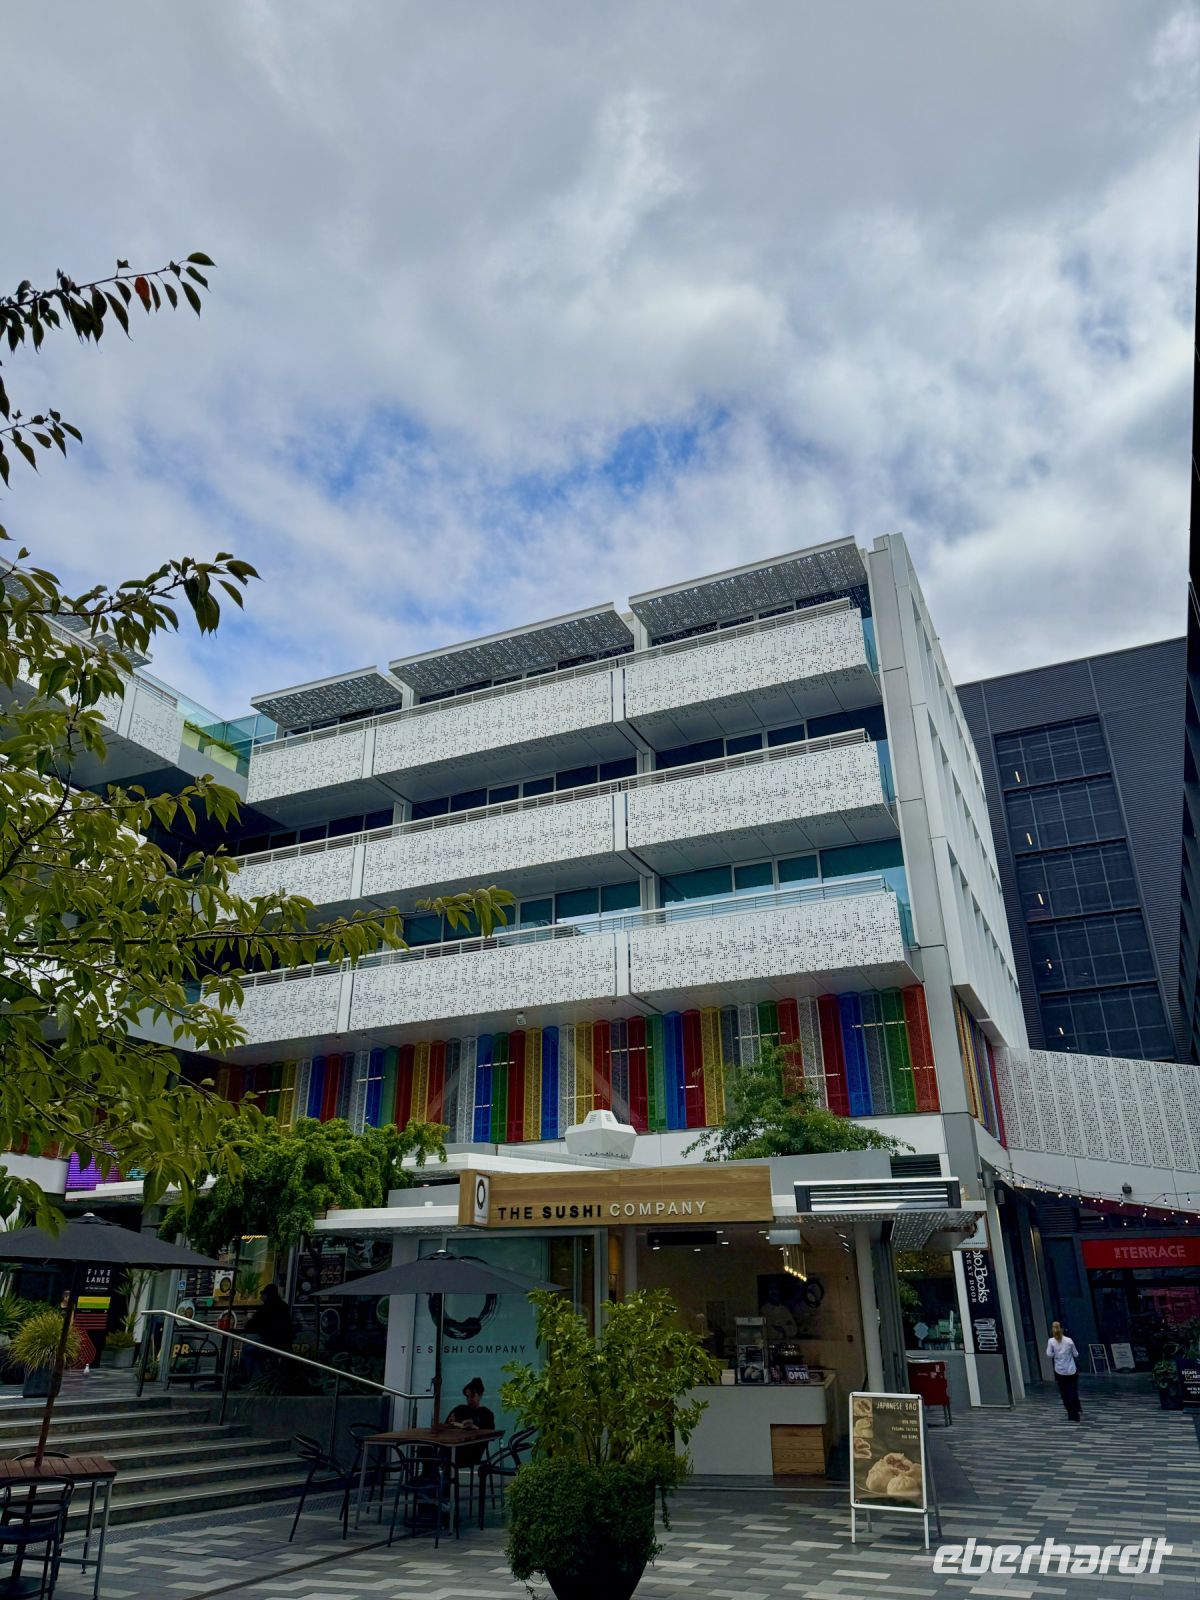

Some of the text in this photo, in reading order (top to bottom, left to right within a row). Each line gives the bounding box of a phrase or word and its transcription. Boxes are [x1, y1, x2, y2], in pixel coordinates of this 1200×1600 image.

[498, 1200, 707, 1220] THE SUSHI COMPANY
[1120, 1245, 1186, 1259] TERRACE
[966, 1252, 974, 1276] NEXT
[87, 1268, 111, 1276] FIVE
[86, 1276, 110, 1284] LANES
[973, 1264, 990, 1303] Books
[401, 1345, 526, 1354] TE SSHI COMPANY
[788, 1371, 809, 1380] OPEN
[876, 1401, 917, 1411] JAPANESE BAO
